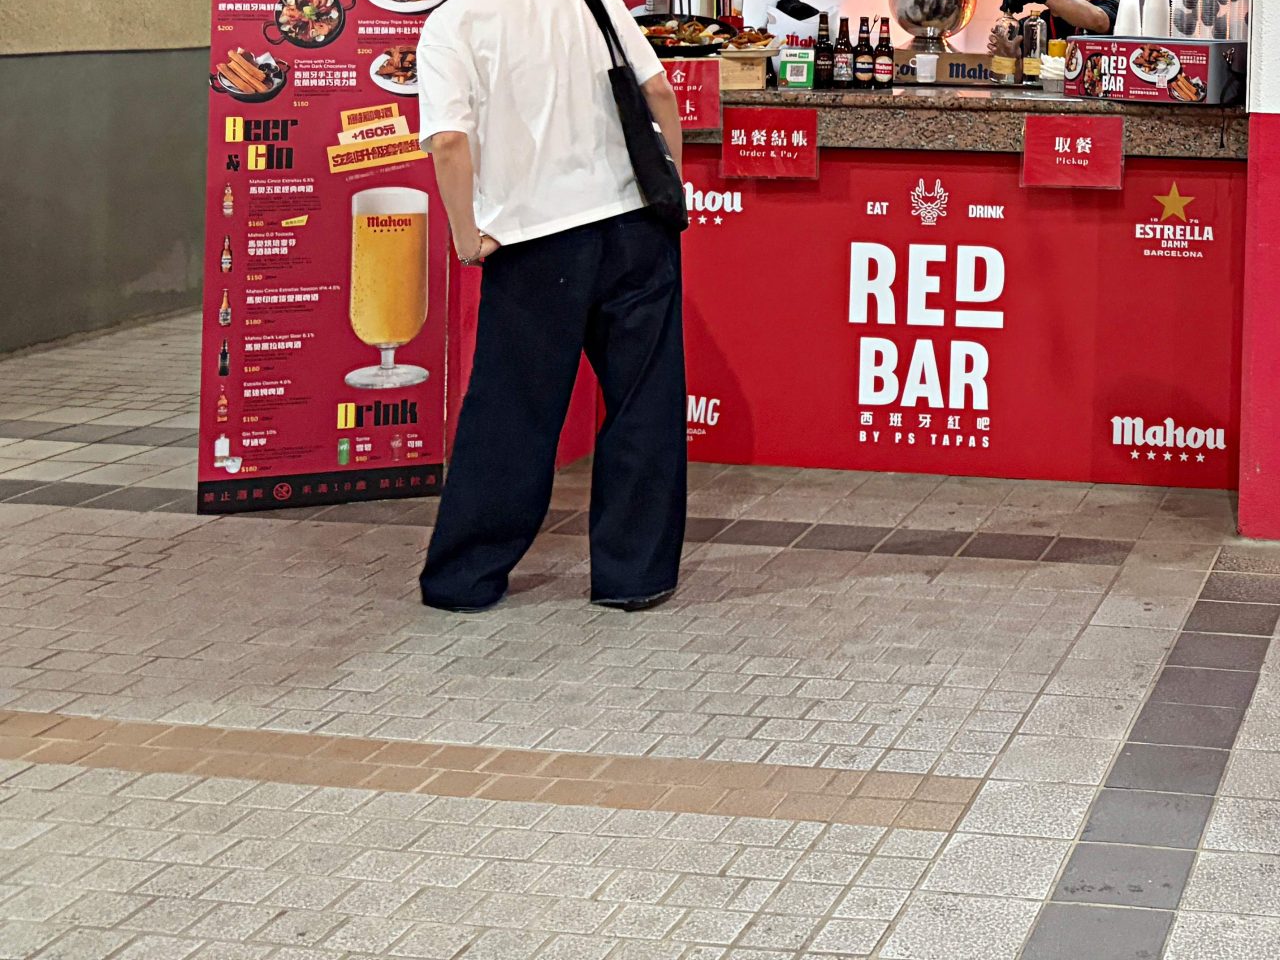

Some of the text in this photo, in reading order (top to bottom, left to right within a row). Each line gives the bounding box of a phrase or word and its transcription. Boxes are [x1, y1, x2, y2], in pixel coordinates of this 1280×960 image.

[1101, 55, 1127, 75] RED
[1102, 76, 1124, 91] BAR
[225, 116, 298, 142] Beer
[352, 124, 396, 140] +160元
[731, 129, 808, 146] 點餐結帳
[739, 149, 766, 158] Order
[770, 149, 777, 158] &
[1054, 136, 1093, 154] 取餐
[248, 144, 293, 170] Gin
[1055, 156, 1089, 166] Pickup
[683, 181, 743, 213] hou
[867, 202, 889, 216] EAT
[968, 204, 1004, 219] DRINK
[366, 216, 412, 228] Mahou
[1135, 223, 1214, 241] ESTRELLA
[1143, 249, 1204, 258] BARCELONA
[1161, 240, 1188, 249] DAMM
[848, 241, 1005, 329] RED
[858, 337, 990, 410] BAR
[337, 399, 418, 429] Drink
[687, 394, 720, 426] MG
[860, 411, 990, 431] 西班牙紅吧
[860, 430, 990, 448] BY PS TAPAS
[1110, 416, 1227, 450] Mahou
